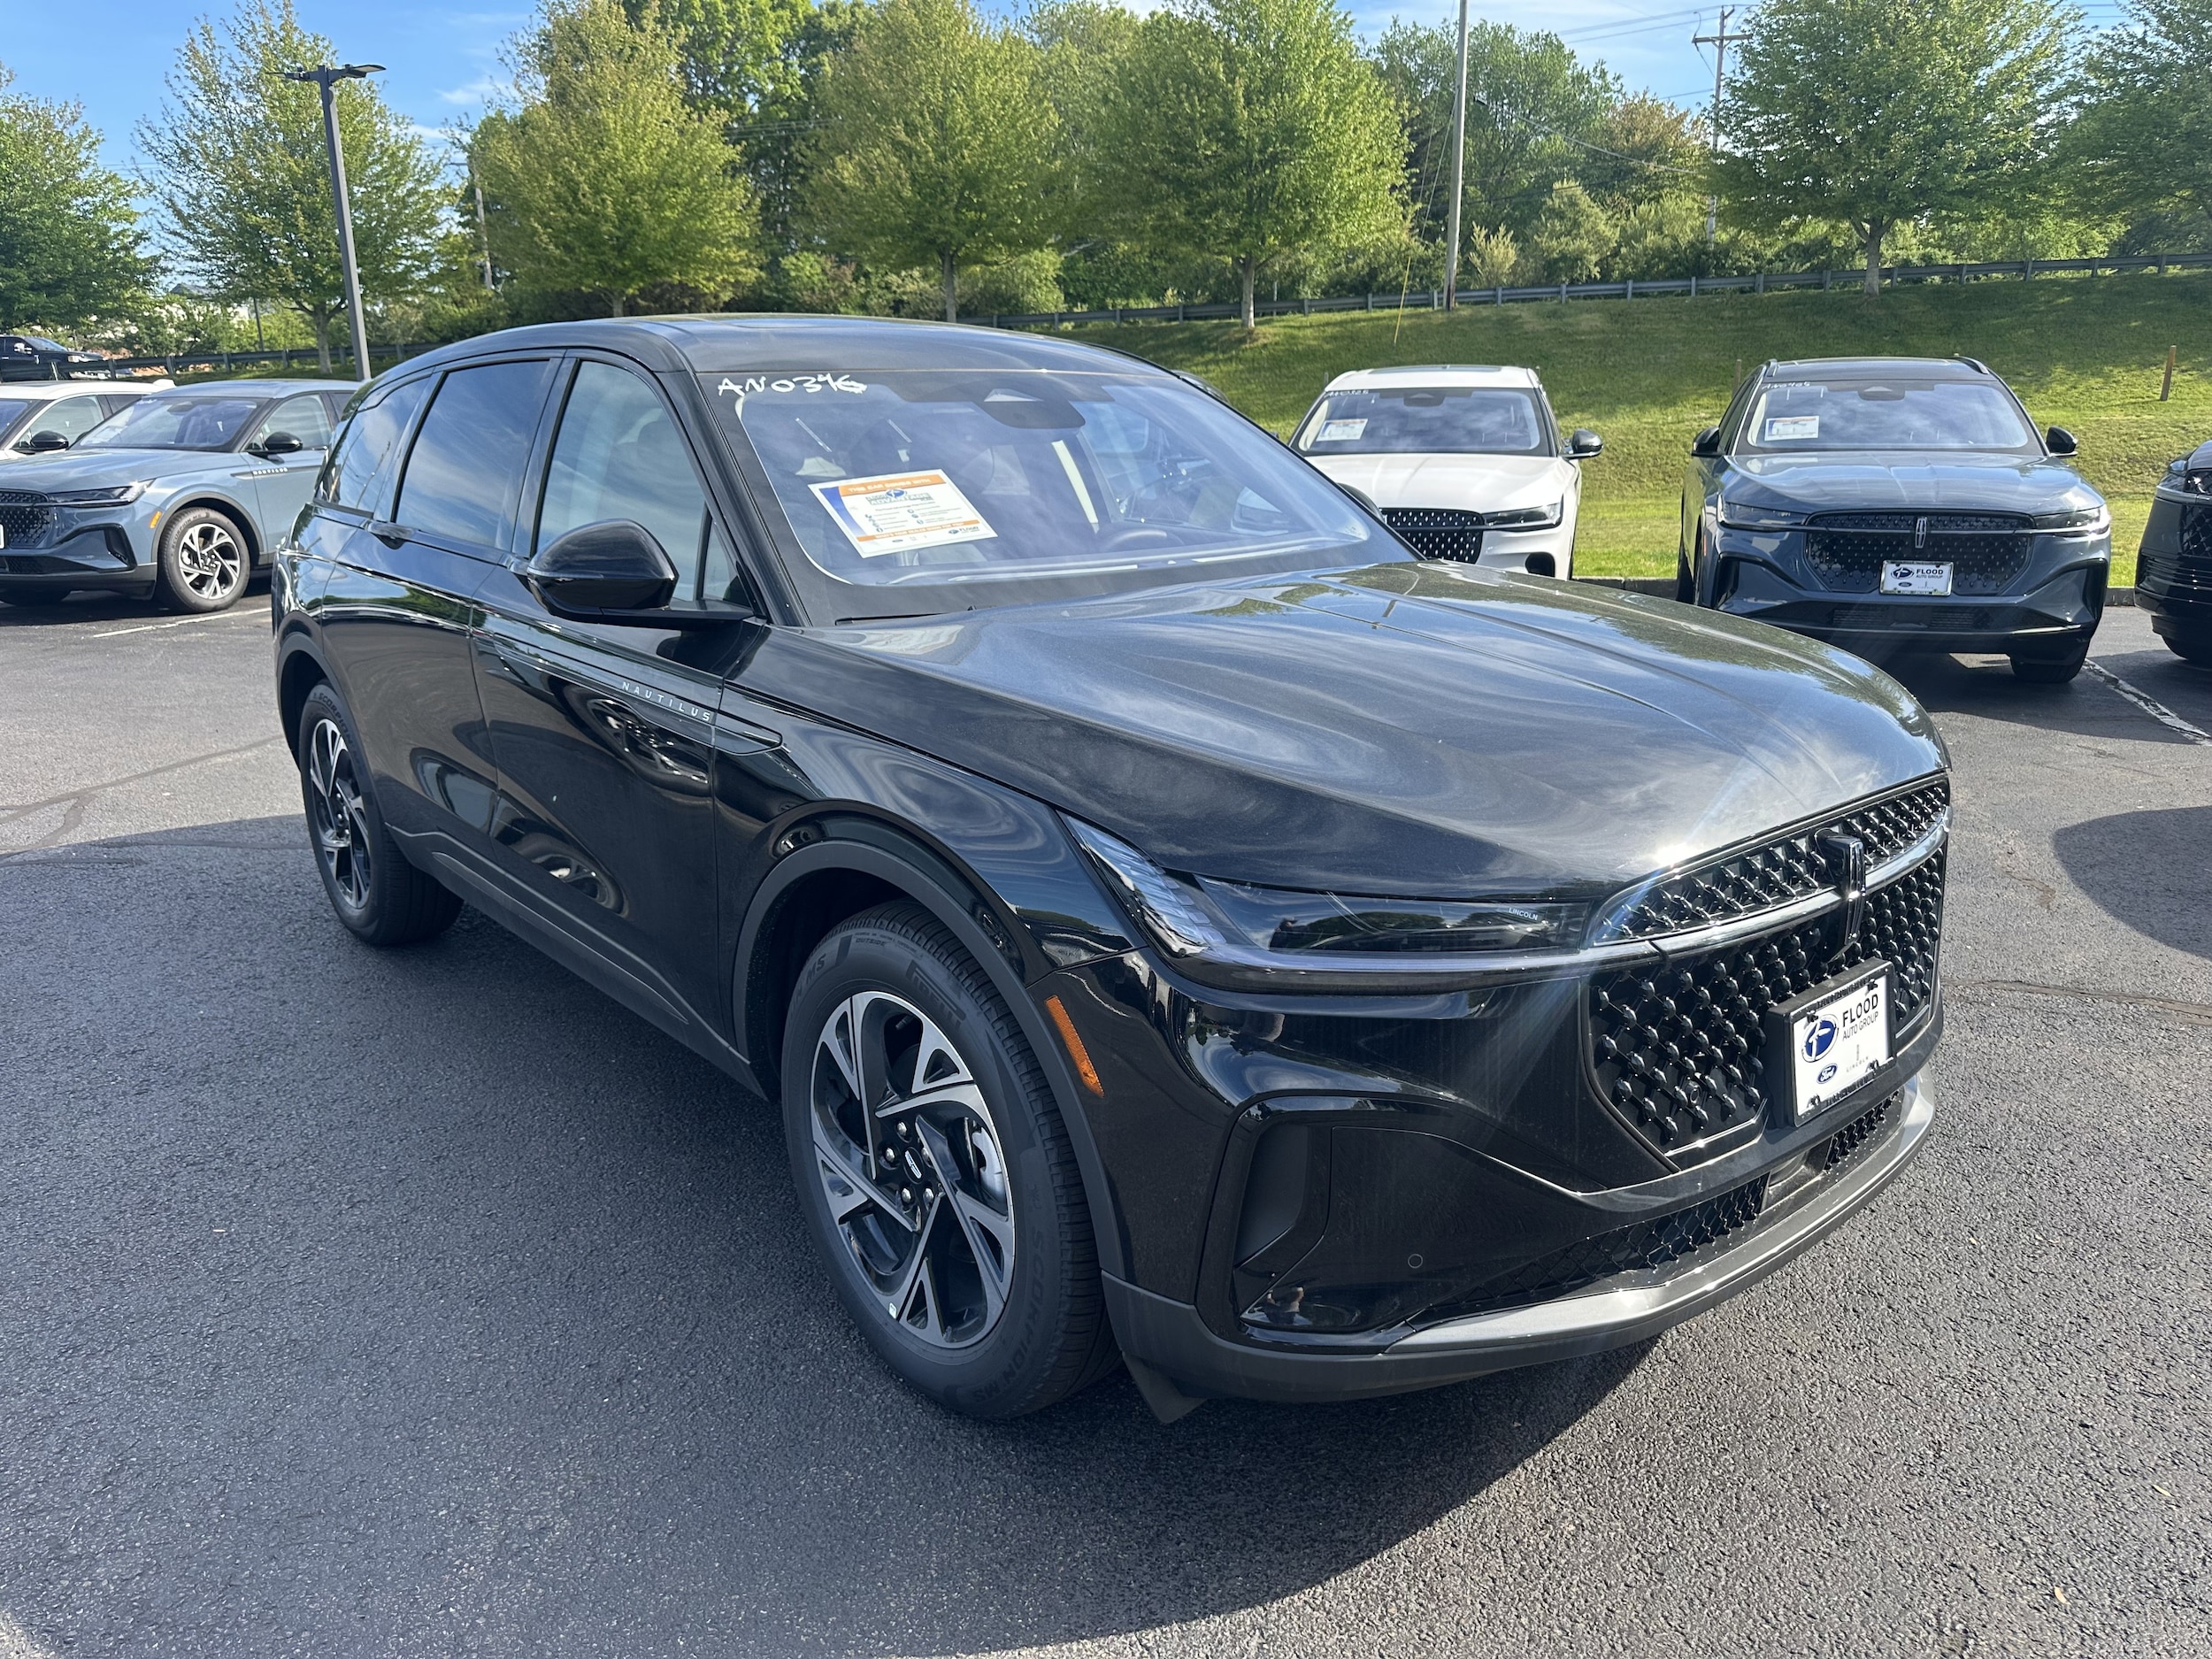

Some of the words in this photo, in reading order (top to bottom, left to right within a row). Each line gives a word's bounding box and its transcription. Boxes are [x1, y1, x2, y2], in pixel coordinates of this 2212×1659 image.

[621, 681, 710, 722] NAUTILUS
[1509, 908, 1538, 920] LINCOLN
[855, 937, 886, 947] OUTSIDE
[1843, 994, 1878, 1028] FLOOD
[1843, 1024, 1858, 1041] AUTO
[1859, 1011, 1878, 1031] GROUP
[1818, 1064, 1837, 1082] Ford
